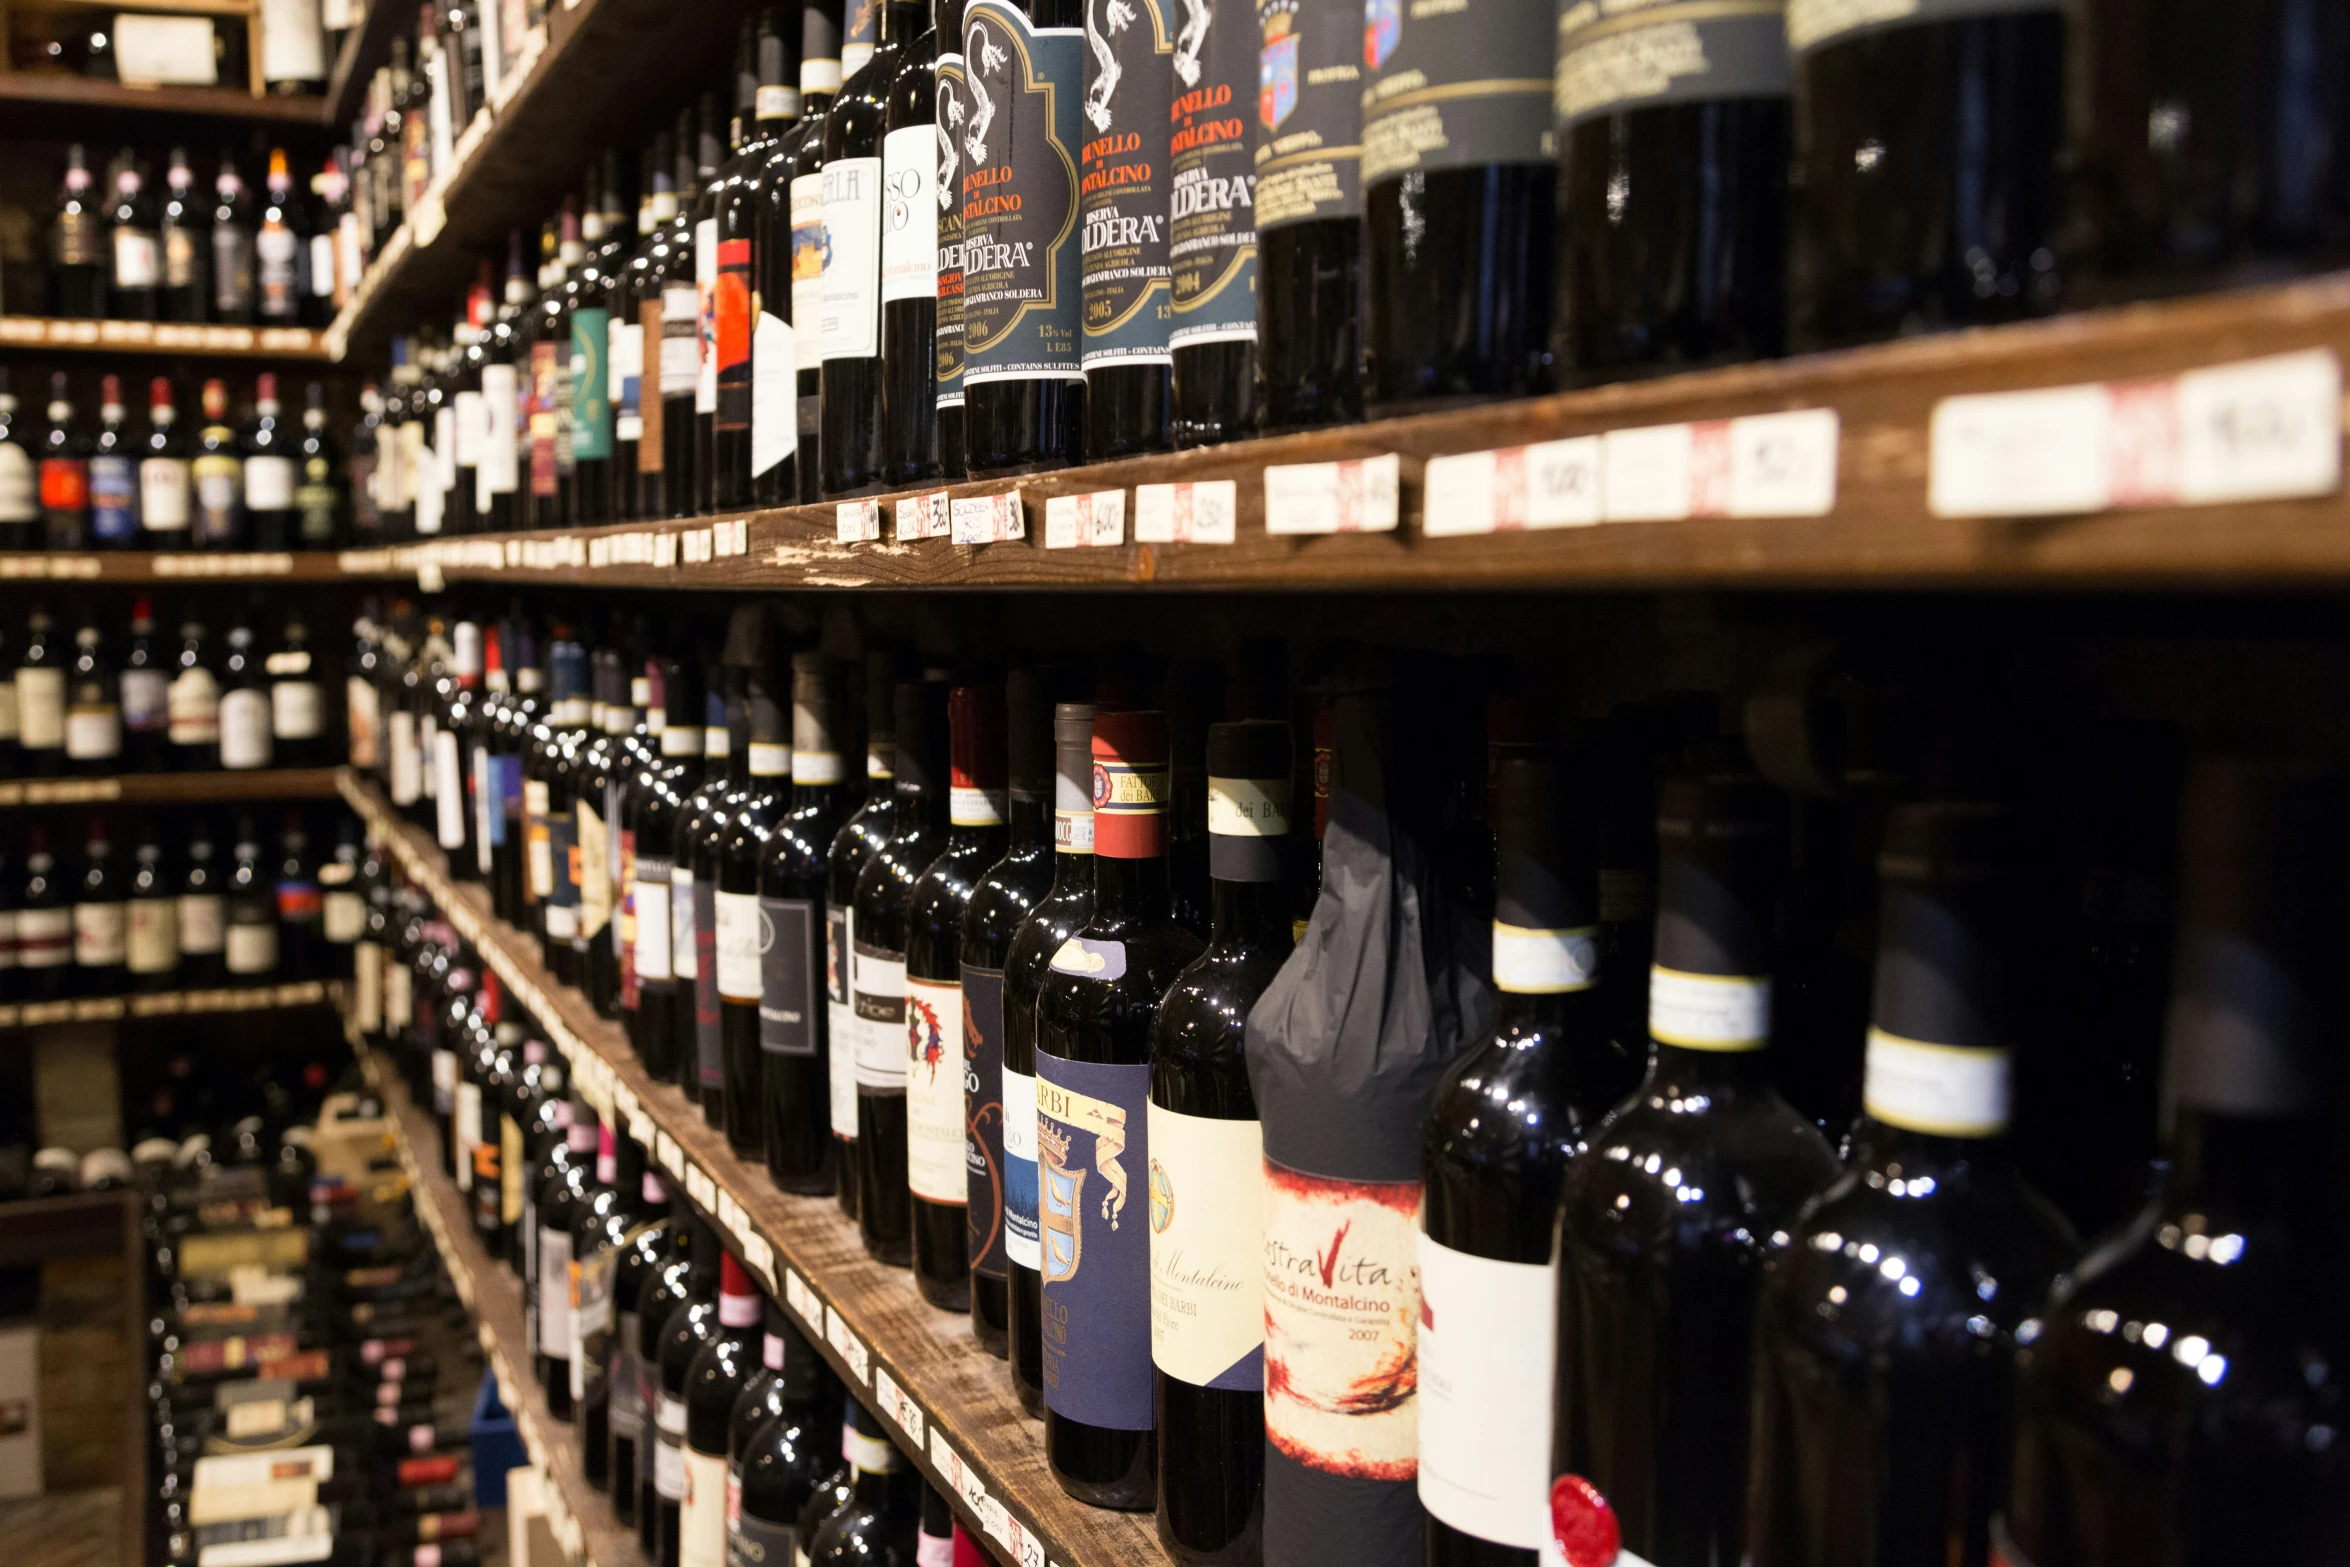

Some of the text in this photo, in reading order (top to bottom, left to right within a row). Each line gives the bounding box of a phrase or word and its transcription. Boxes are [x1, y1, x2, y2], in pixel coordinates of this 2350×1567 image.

[1130, 265, 1171, 277] SOLDERA
[1004, 289, 1042, 299] SOLDERA
[1089, 300, 1112, 320] 2005
[968, 320, 988, 339] 2006
[1007, 362, 1042, 371] CONTAINS
[1043, 362, 1080, 370] SULFITES
[1121, 789, 1133, 802] dei
[1235, 802, 1253, 818] dei
[1166, 1248, 1244, 1292] Montalcino
[1288, 1283, 1299, 1299] di
[1302, 1287, 1391, 1313] Montalcino
[1170, 1296, 1198, 1317] BARBI
[1349, 1328, 1379, 1342] 2007
